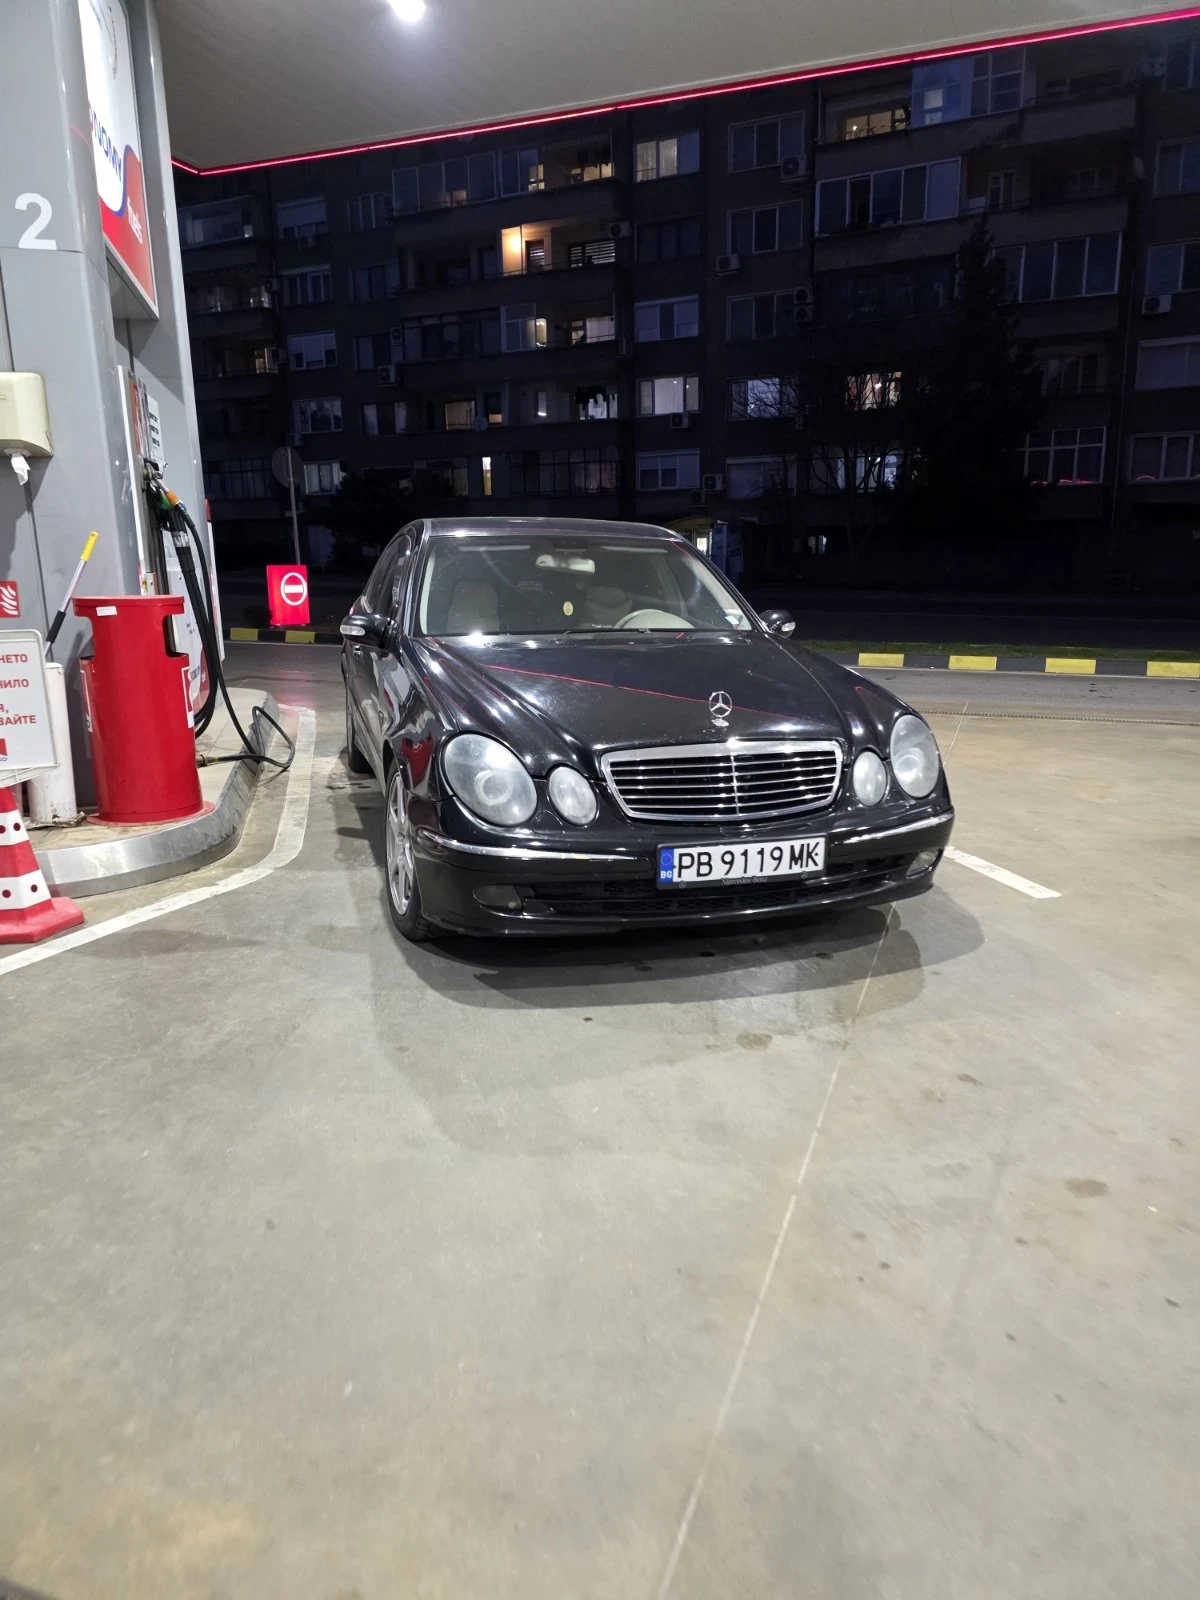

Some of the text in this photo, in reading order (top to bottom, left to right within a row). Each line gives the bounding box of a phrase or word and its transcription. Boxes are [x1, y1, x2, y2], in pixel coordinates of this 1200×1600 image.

[14, 192, 57, 250] 2
[660, 870, 673, 879] BG
[677, 842, 820, 878] PB 9119 MK
